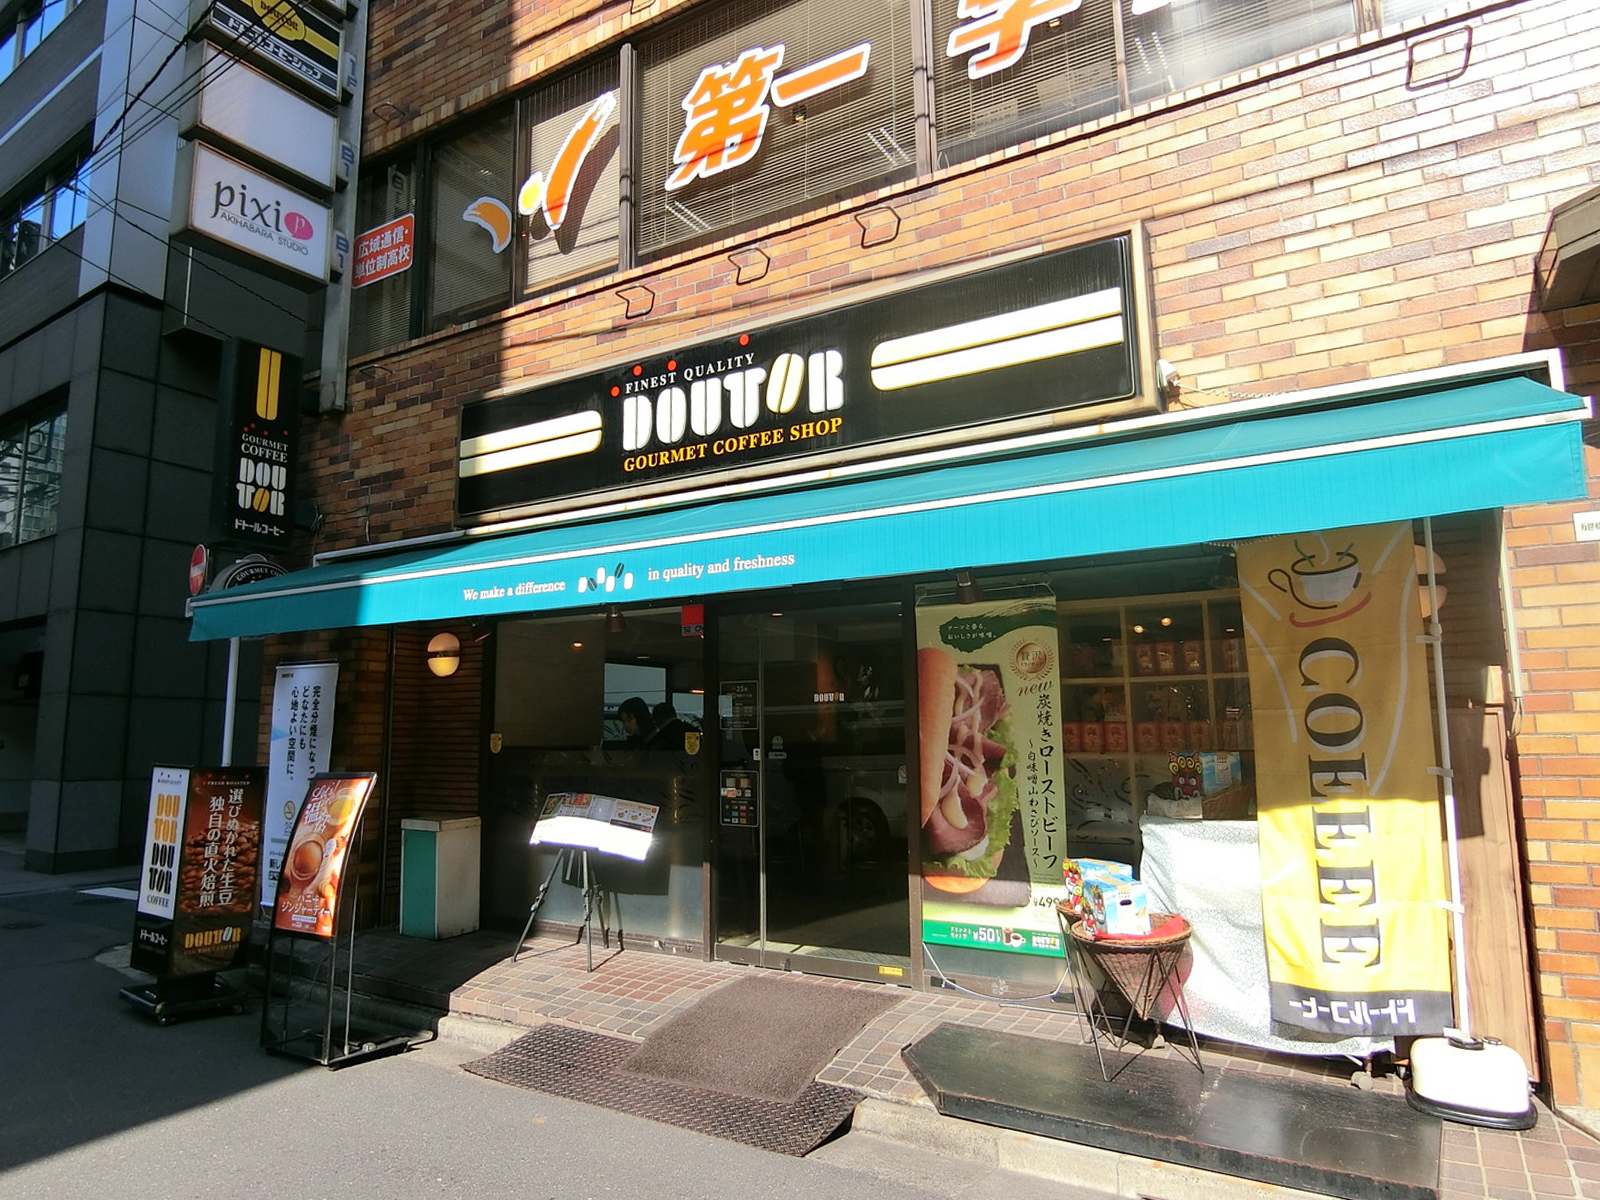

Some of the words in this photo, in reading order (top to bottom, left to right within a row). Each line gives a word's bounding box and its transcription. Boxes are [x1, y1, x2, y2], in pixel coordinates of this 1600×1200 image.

[210, 181, 282, 233] pixi
[220, 211, 274, 241] AKIHABARA
[277, 236, 309, 256] STUDIO
[354, 243, 411, 278] 単位制高校
[625, 371, 677, 394] FINEST
[683, 352, 755, 381] QUALITY
[622, 349, 844, 452] DOUTOR
[240, 443, 288, 463] COFFEE
[241, 433, 288, 452] GOURMET
[623, 443, 708, 472] GOURMET
[712, 428, 784, 456] COFFEE
[789, 416, 843, 441] SHOP
[234, 518, 286, 537] ドトールコーヒー
[236, 567, 269, 582] GOURMET
[463, 588, 479, 601] We
[479, 585, 505, 599] make
[507, 588, 514, 597] a
[514, 579, 566, 595] difference
[648, 566, 661, 581] in
[662, 562, 704, 584] quality
[707, 562, 731, 576] and
[733, 553, 796, 572] freshness
[1017, 680, 1053, 697] new
[299, 685, 311, 750] どなたにも
[1036, 694, 1059, 869] 炭焼きローストビーフ
[198, 796, 226, 907] 独自の直火焙煎
[218, 788, 244, 905] 選びぬかれた生豆
[146, 894, 170, 909] COFFEE
[184, 926, 241, 949] DOUTOR
